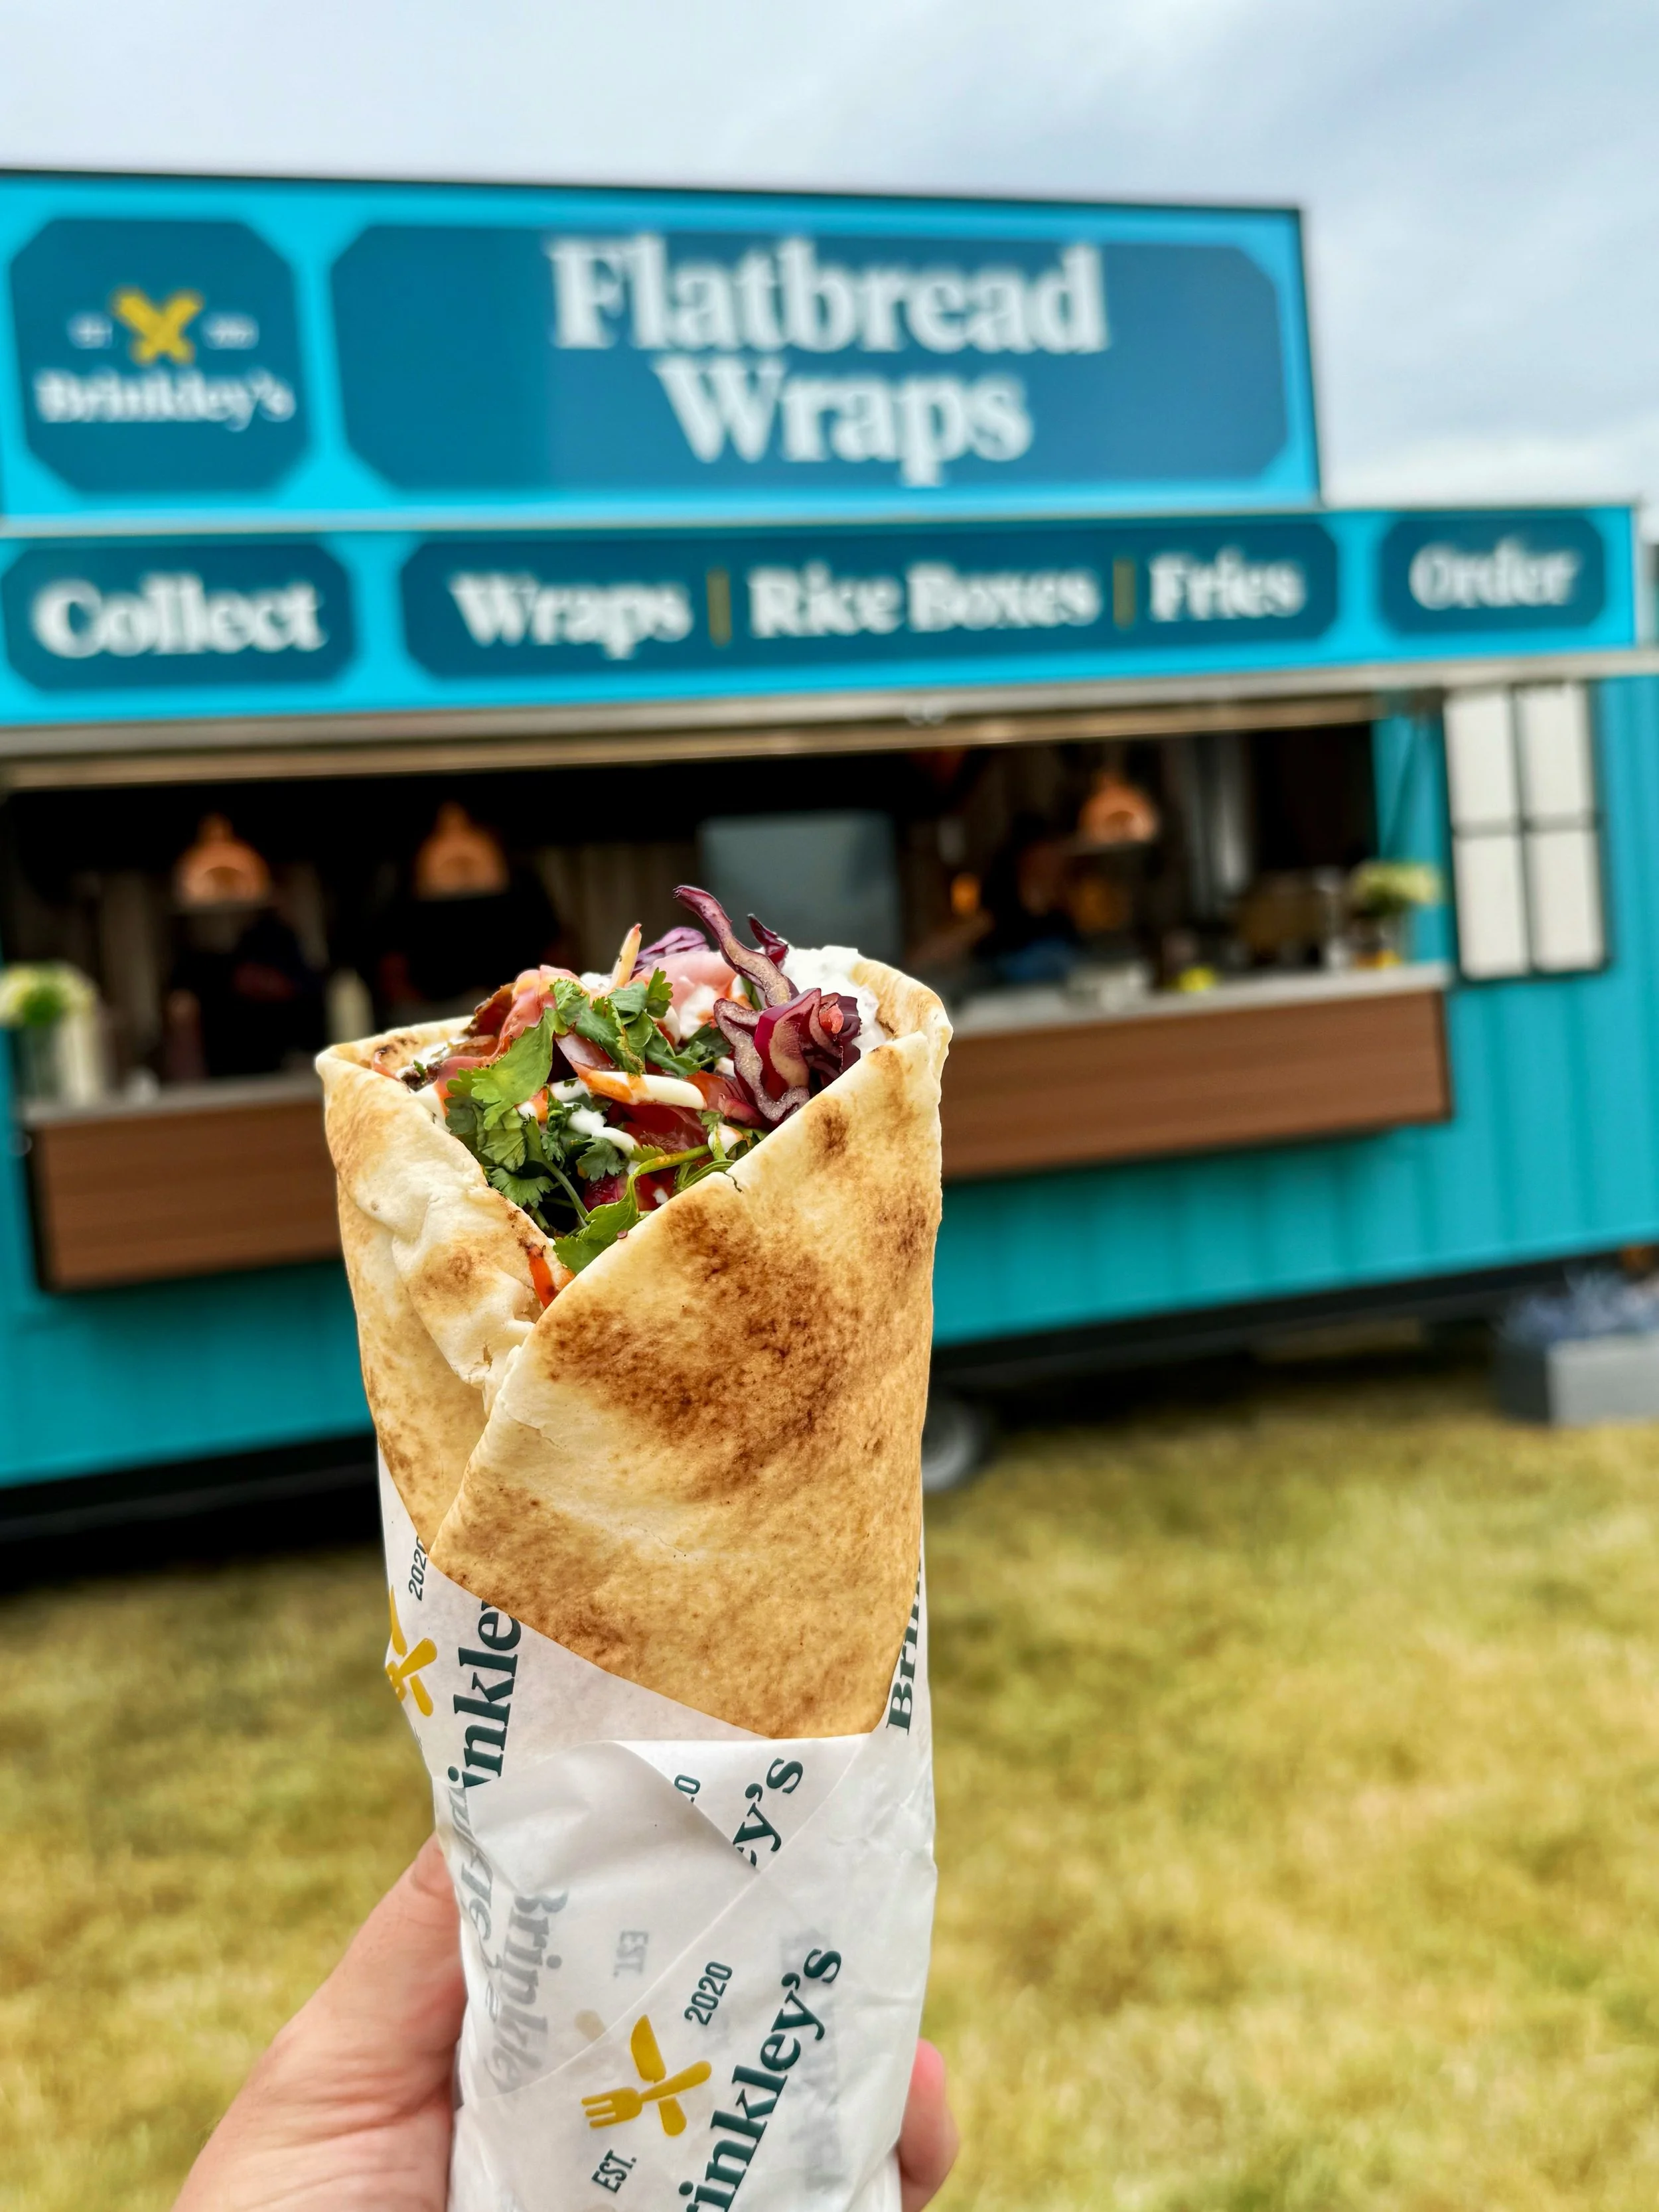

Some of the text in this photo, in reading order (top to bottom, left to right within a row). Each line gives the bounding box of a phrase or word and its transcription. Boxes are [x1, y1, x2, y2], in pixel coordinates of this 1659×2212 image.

[545, 230, 1110, 354] Flatbread
[33, 368, 297, 432] Brinkley's
[652, 355, 1035, 486] Wraps
[32, 569, 328, 658] Collect
[449, 544, 1307, 660] Wraps Rice Boxes Fries
[1408, 536, 1582, 611] Order
[447, 1600, 522, 1789] inkle
[684, 1961, 733, 2026] 2020
[678, 1949, 842, 2212] inkley's
[591, 2148, 637, 2194] EST.
